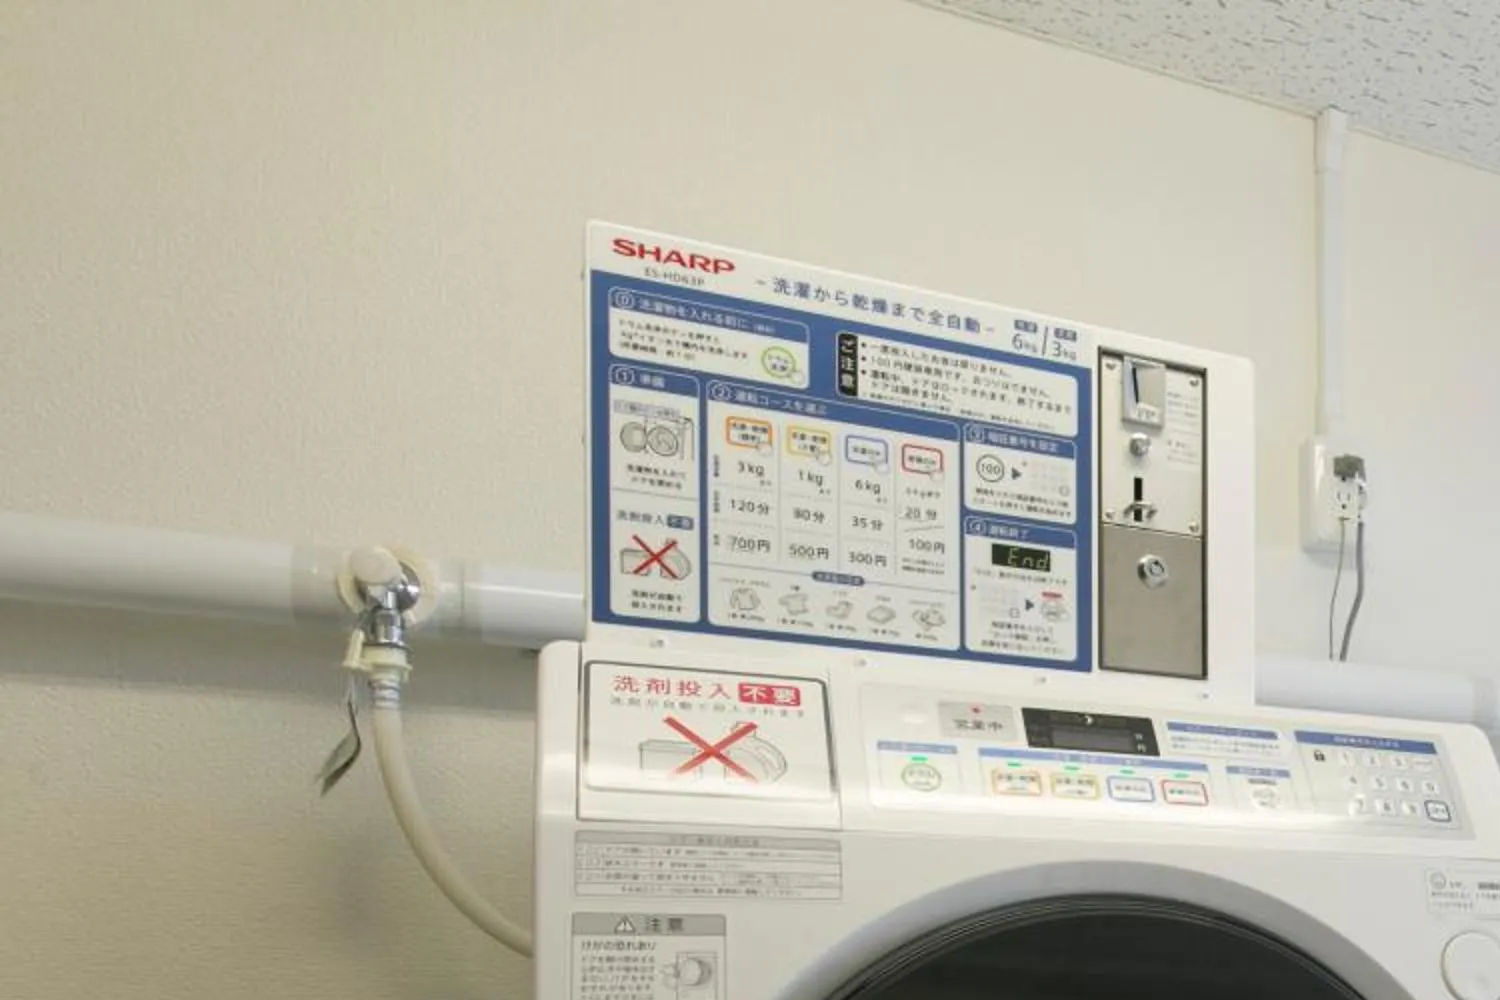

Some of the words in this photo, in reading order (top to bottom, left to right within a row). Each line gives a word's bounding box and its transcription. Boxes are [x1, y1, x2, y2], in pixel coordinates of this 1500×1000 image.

[612, 237, 736, 275] SHARP
[1007, 547, 1049, 570] End
[613, 674, 732, 700] 洗剤投入
